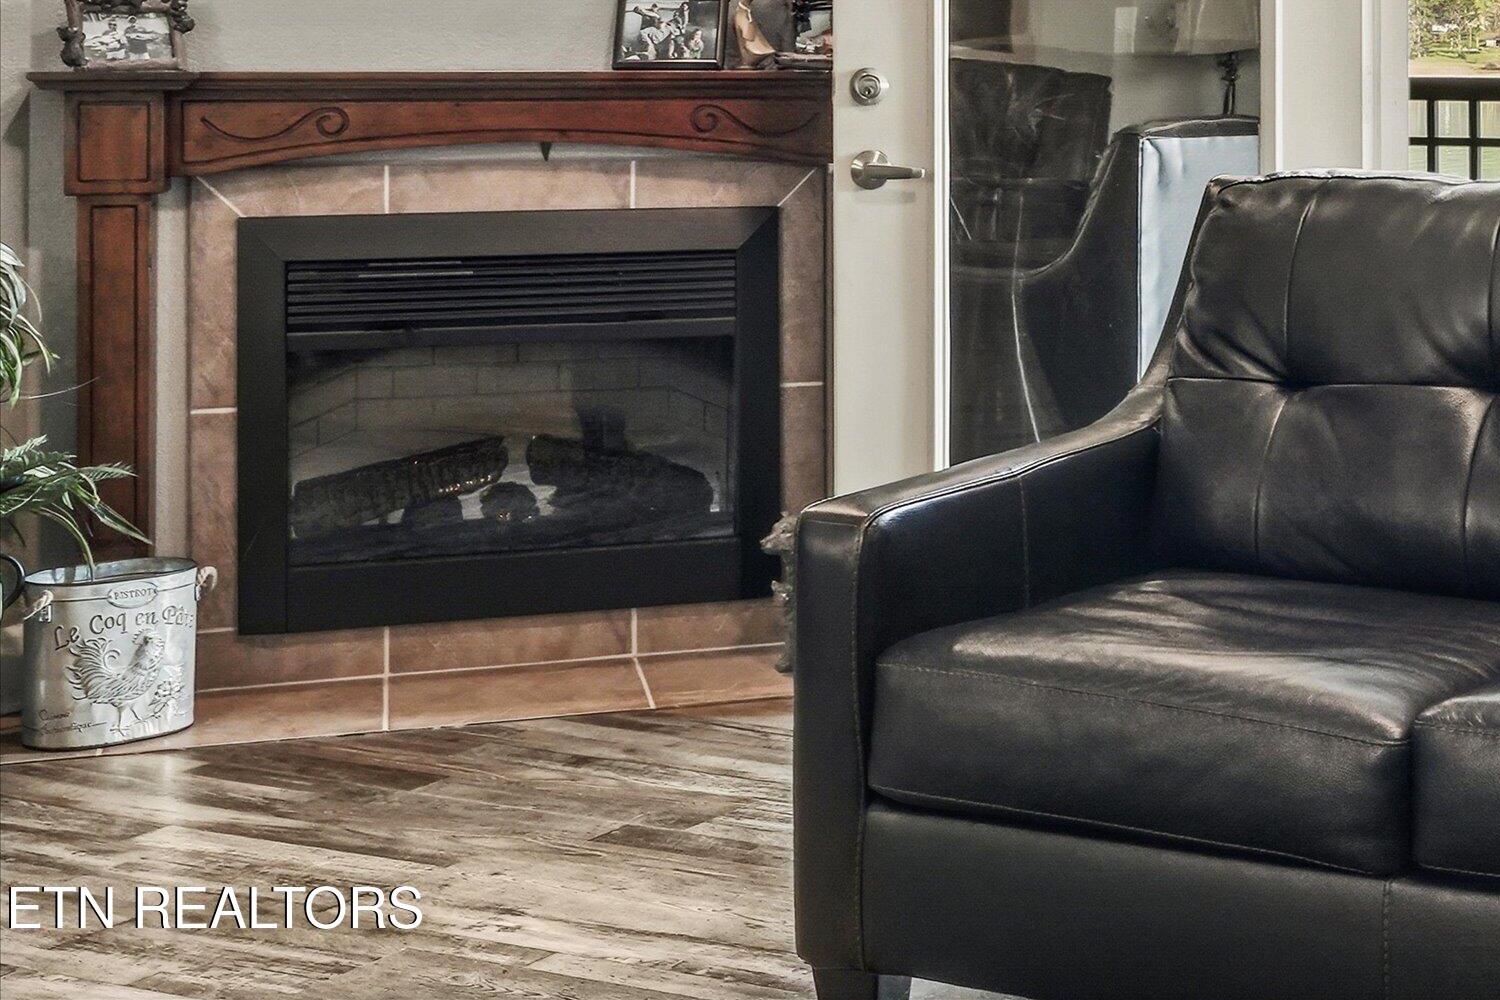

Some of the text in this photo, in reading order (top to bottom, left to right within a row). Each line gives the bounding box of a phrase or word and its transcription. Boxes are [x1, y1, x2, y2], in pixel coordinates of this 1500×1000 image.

[54, 626, 80, 651] Le
[90, 612, 128, 635] Coq
[135, 611, 158, 626] en
